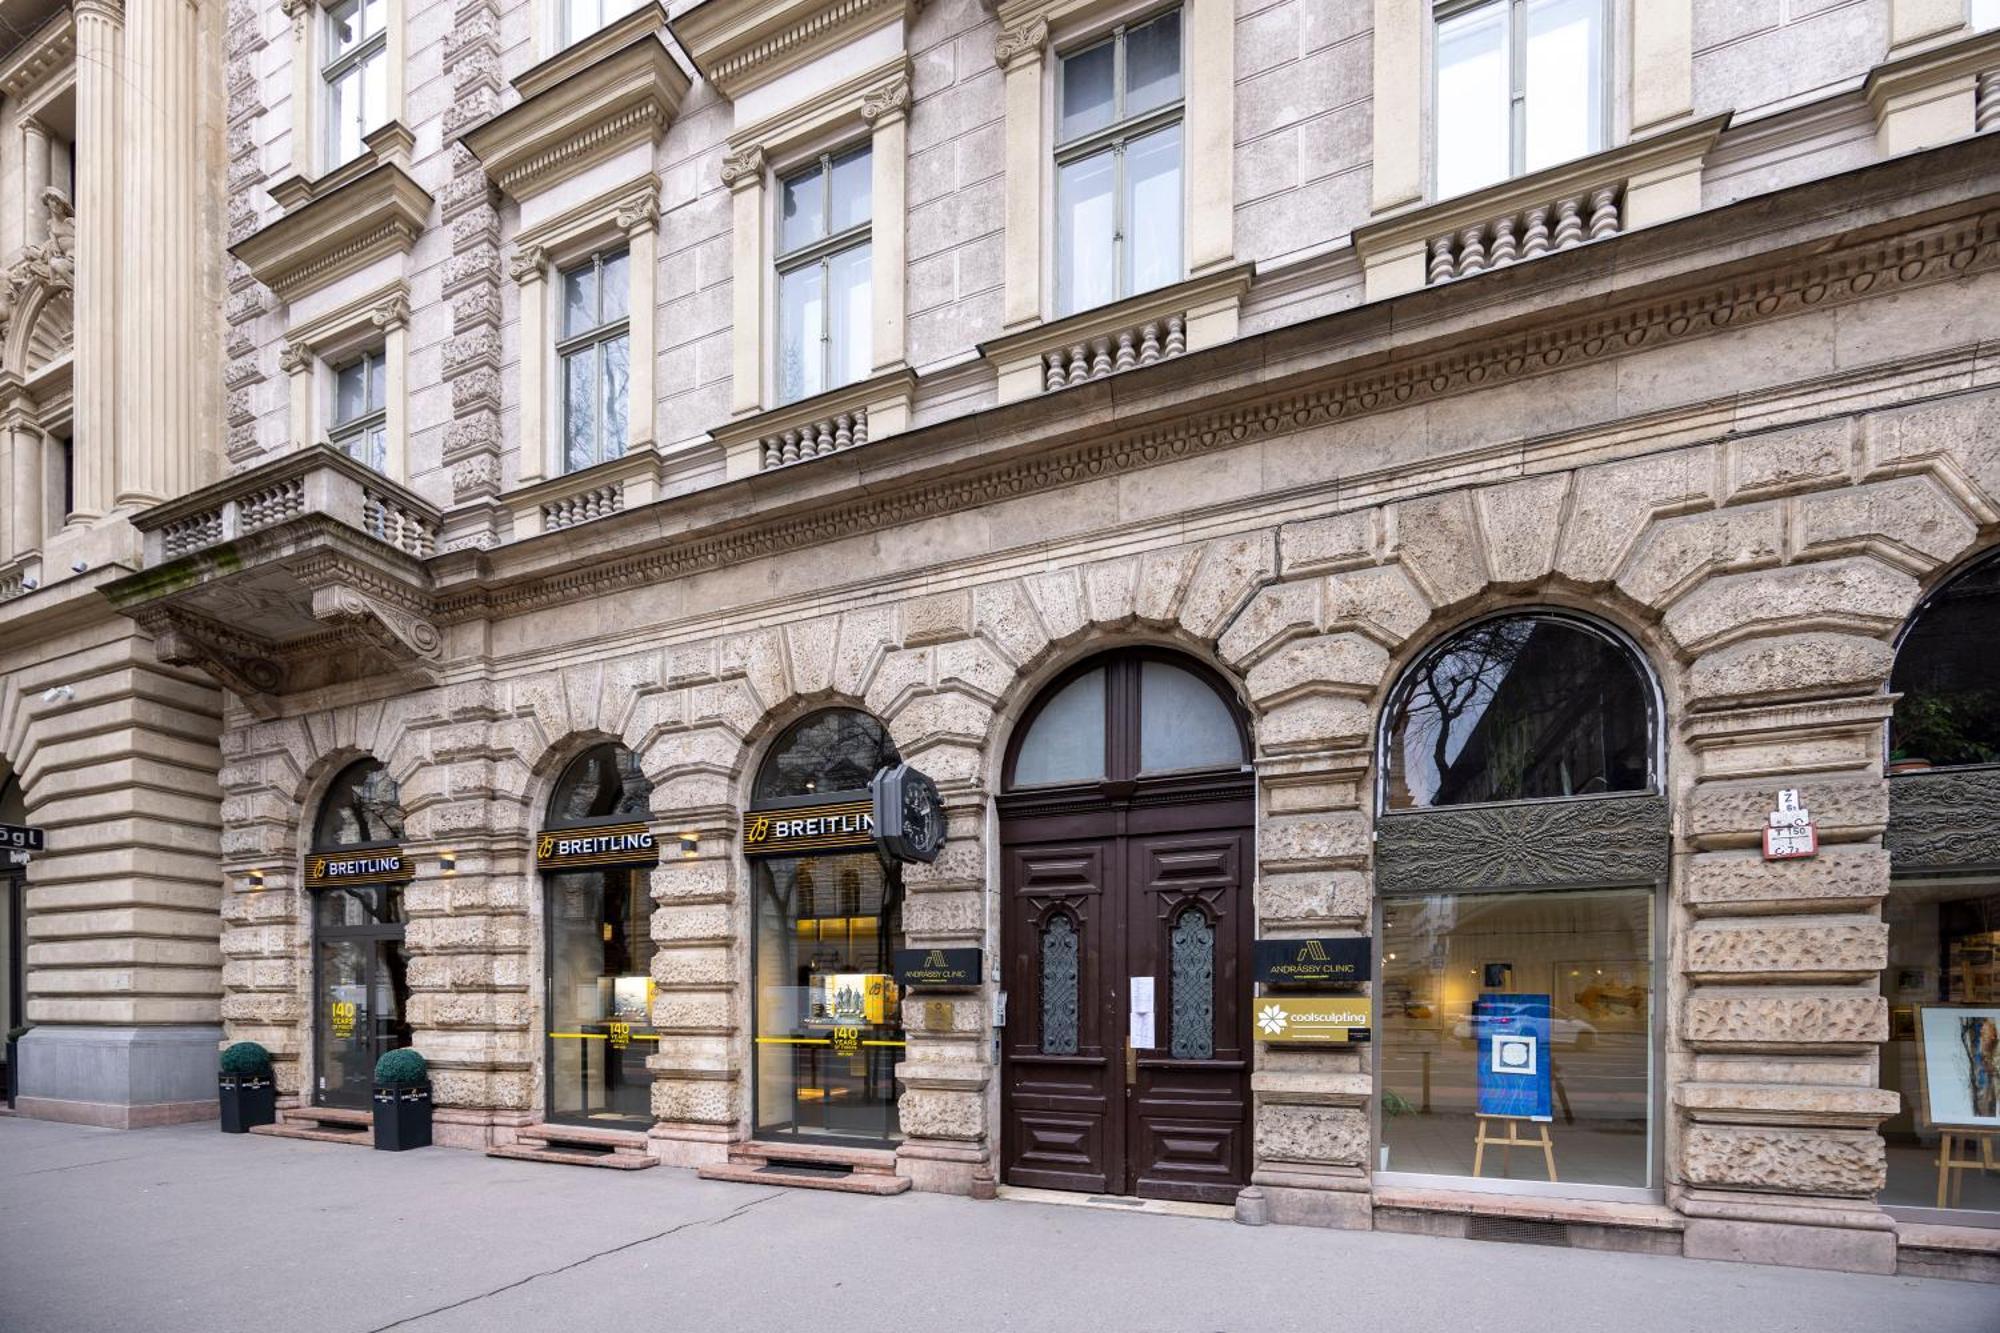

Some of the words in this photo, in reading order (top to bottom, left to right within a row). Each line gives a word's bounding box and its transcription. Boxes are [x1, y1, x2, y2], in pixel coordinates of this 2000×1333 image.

[775, 813, 875, 838] BREITLIN
[559, 832, 653, 855] BREITLING
[328, 856, 400, 876] BREITLING
[942, 970, 967, 978] CLINIC
[1322, 964, 1355, 973] CLINIC
[332, 1002, 354, 1018] 140
[1290, 1011, 1367, 1025] coolsculpting
[610, 1023, 630, 1034] 140
[833, 1026, 858, 1040] 140
